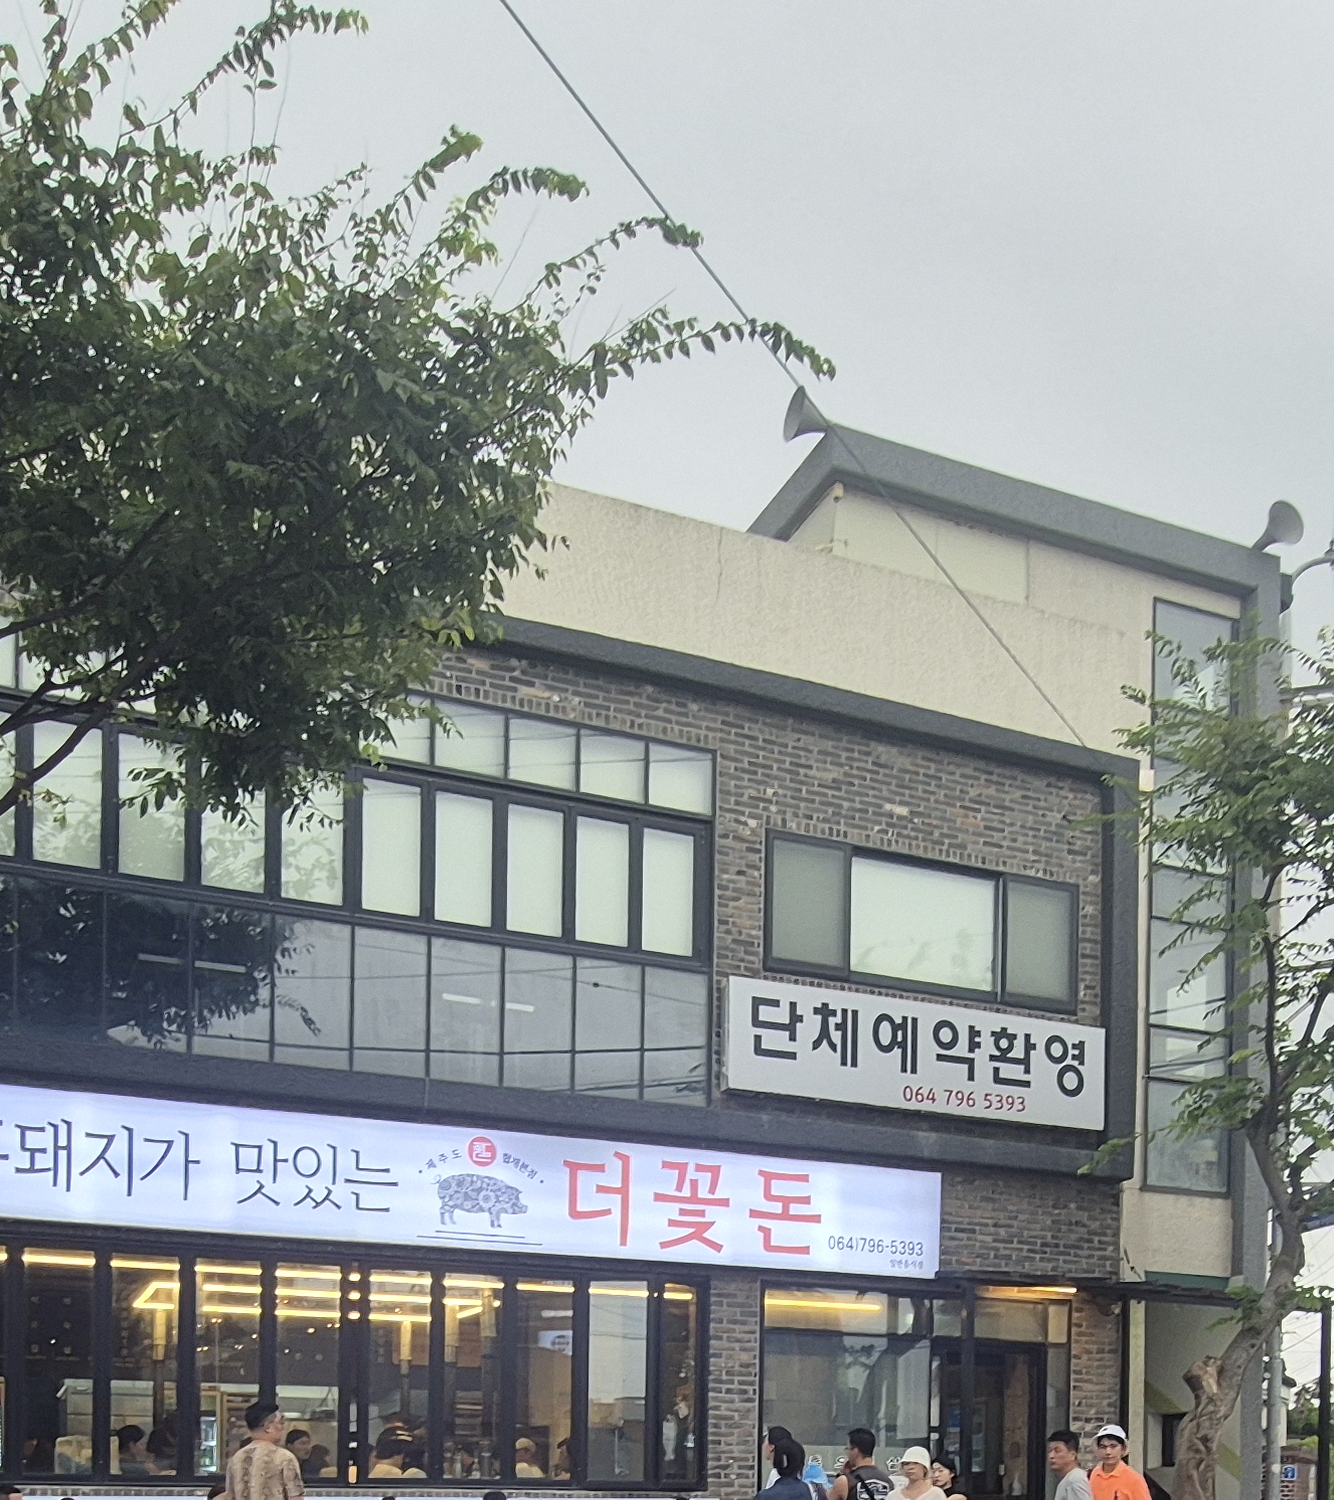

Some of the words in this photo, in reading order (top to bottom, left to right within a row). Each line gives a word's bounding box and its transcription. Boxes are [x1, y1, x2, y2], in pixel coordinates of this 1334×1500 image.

[751, 996, 1085, 1097] 단체예약환영
[902, 1085, 937, 1105] 064
[944, 1089, 977, 1108] 796
[983, 1093, 1027, 1113] 5393
[230, 1137, 399, 1213] 맛있는
[563, 1150, 822, 1256] 더꽃돈
[827, 1235, 925, 1257] 064)796-5393
